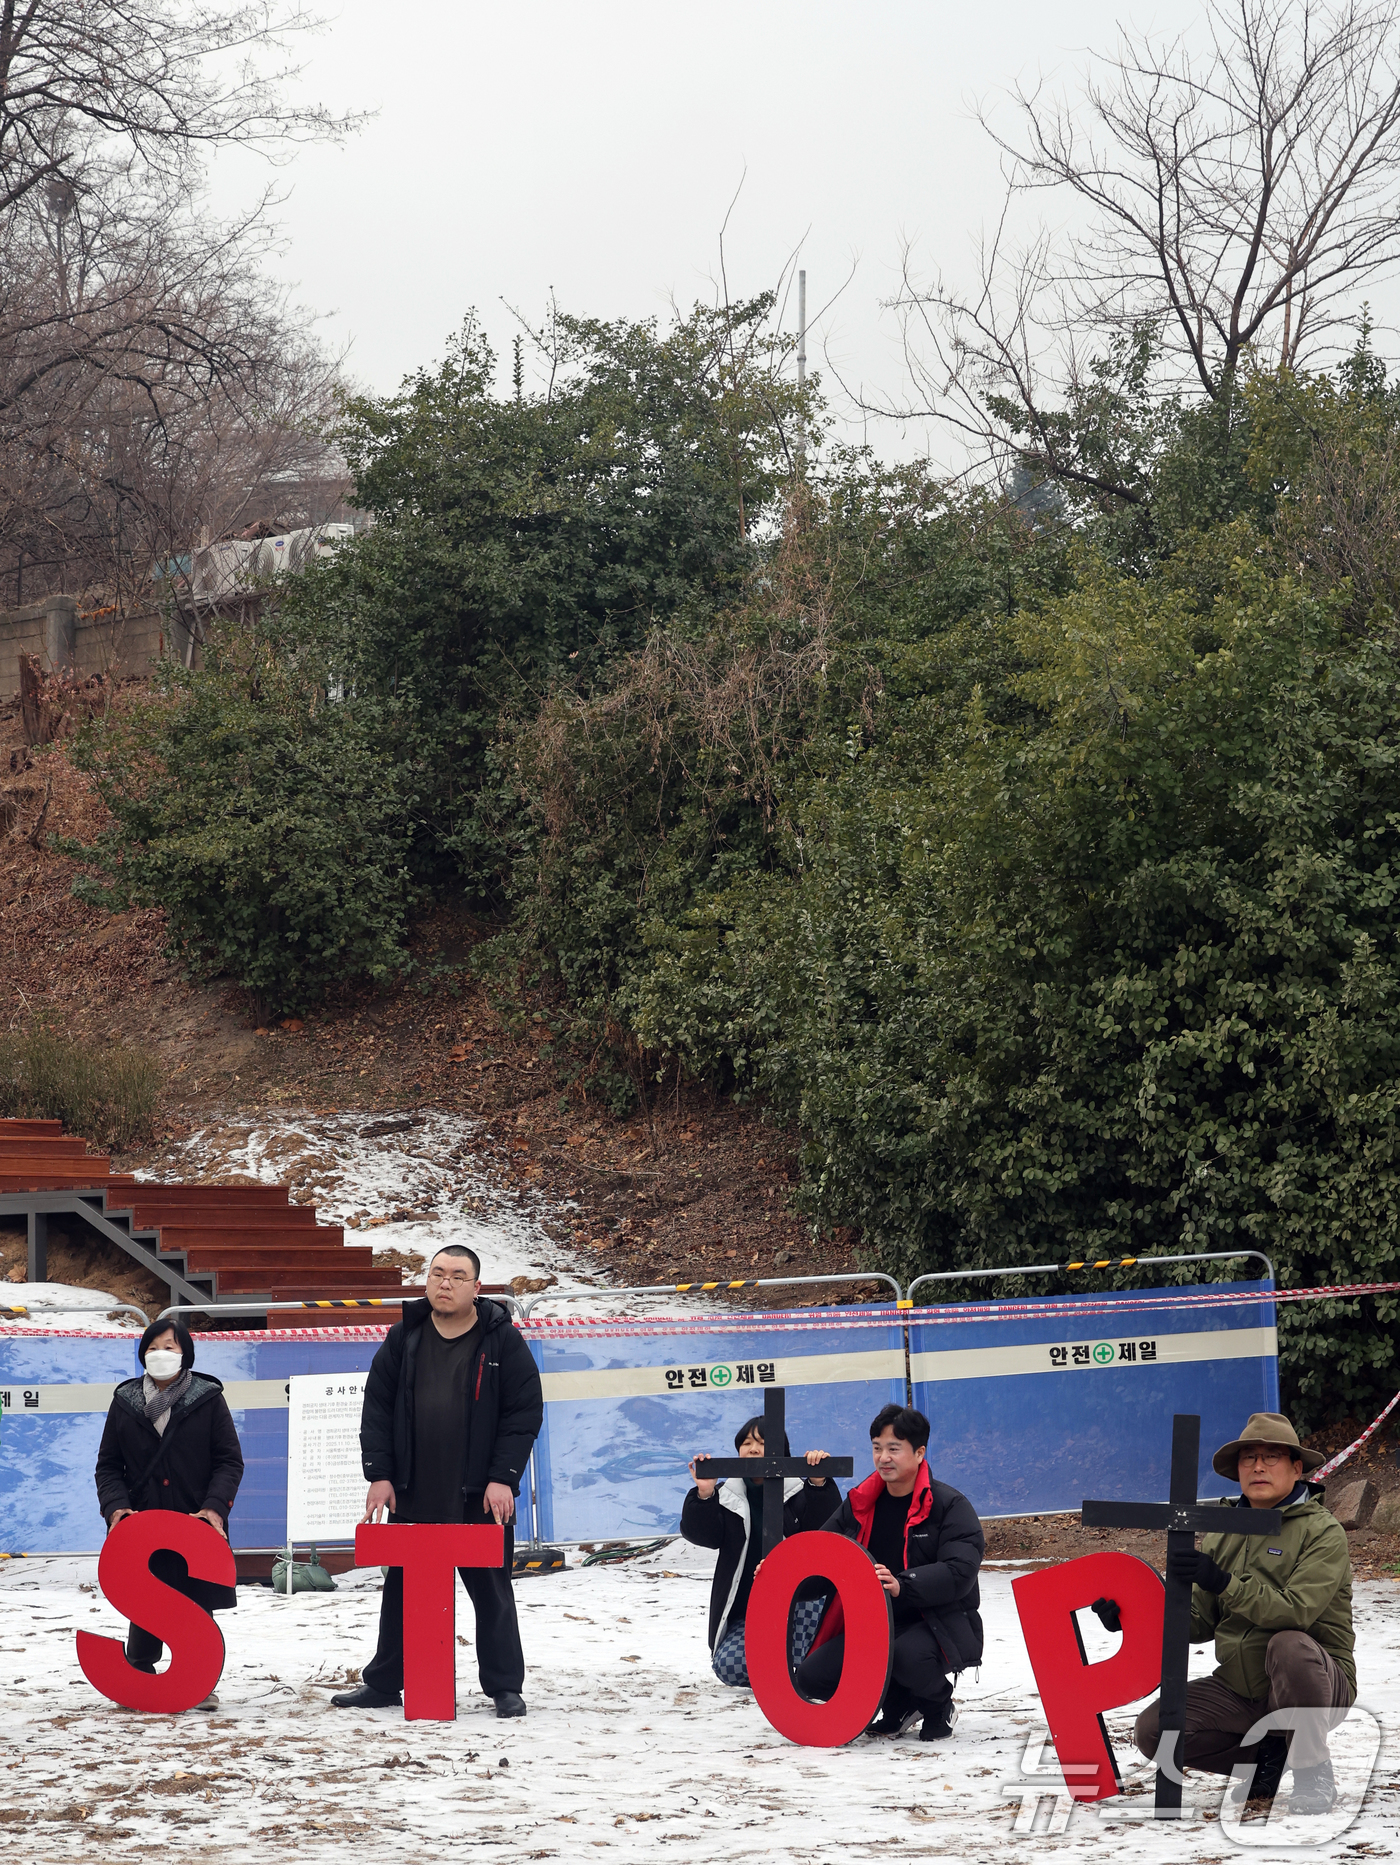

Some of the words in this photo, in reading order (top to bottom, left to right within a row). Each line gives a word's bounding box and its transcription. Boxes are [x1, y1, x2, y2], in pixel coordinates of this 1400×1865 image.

[1049, 1345, 1090, 1366] 안전
[1118, 1341, 1157, 1361] 제일
[665, 1368, 707, 1389] 안전
[736, 1363, 776, 1384] 제일
